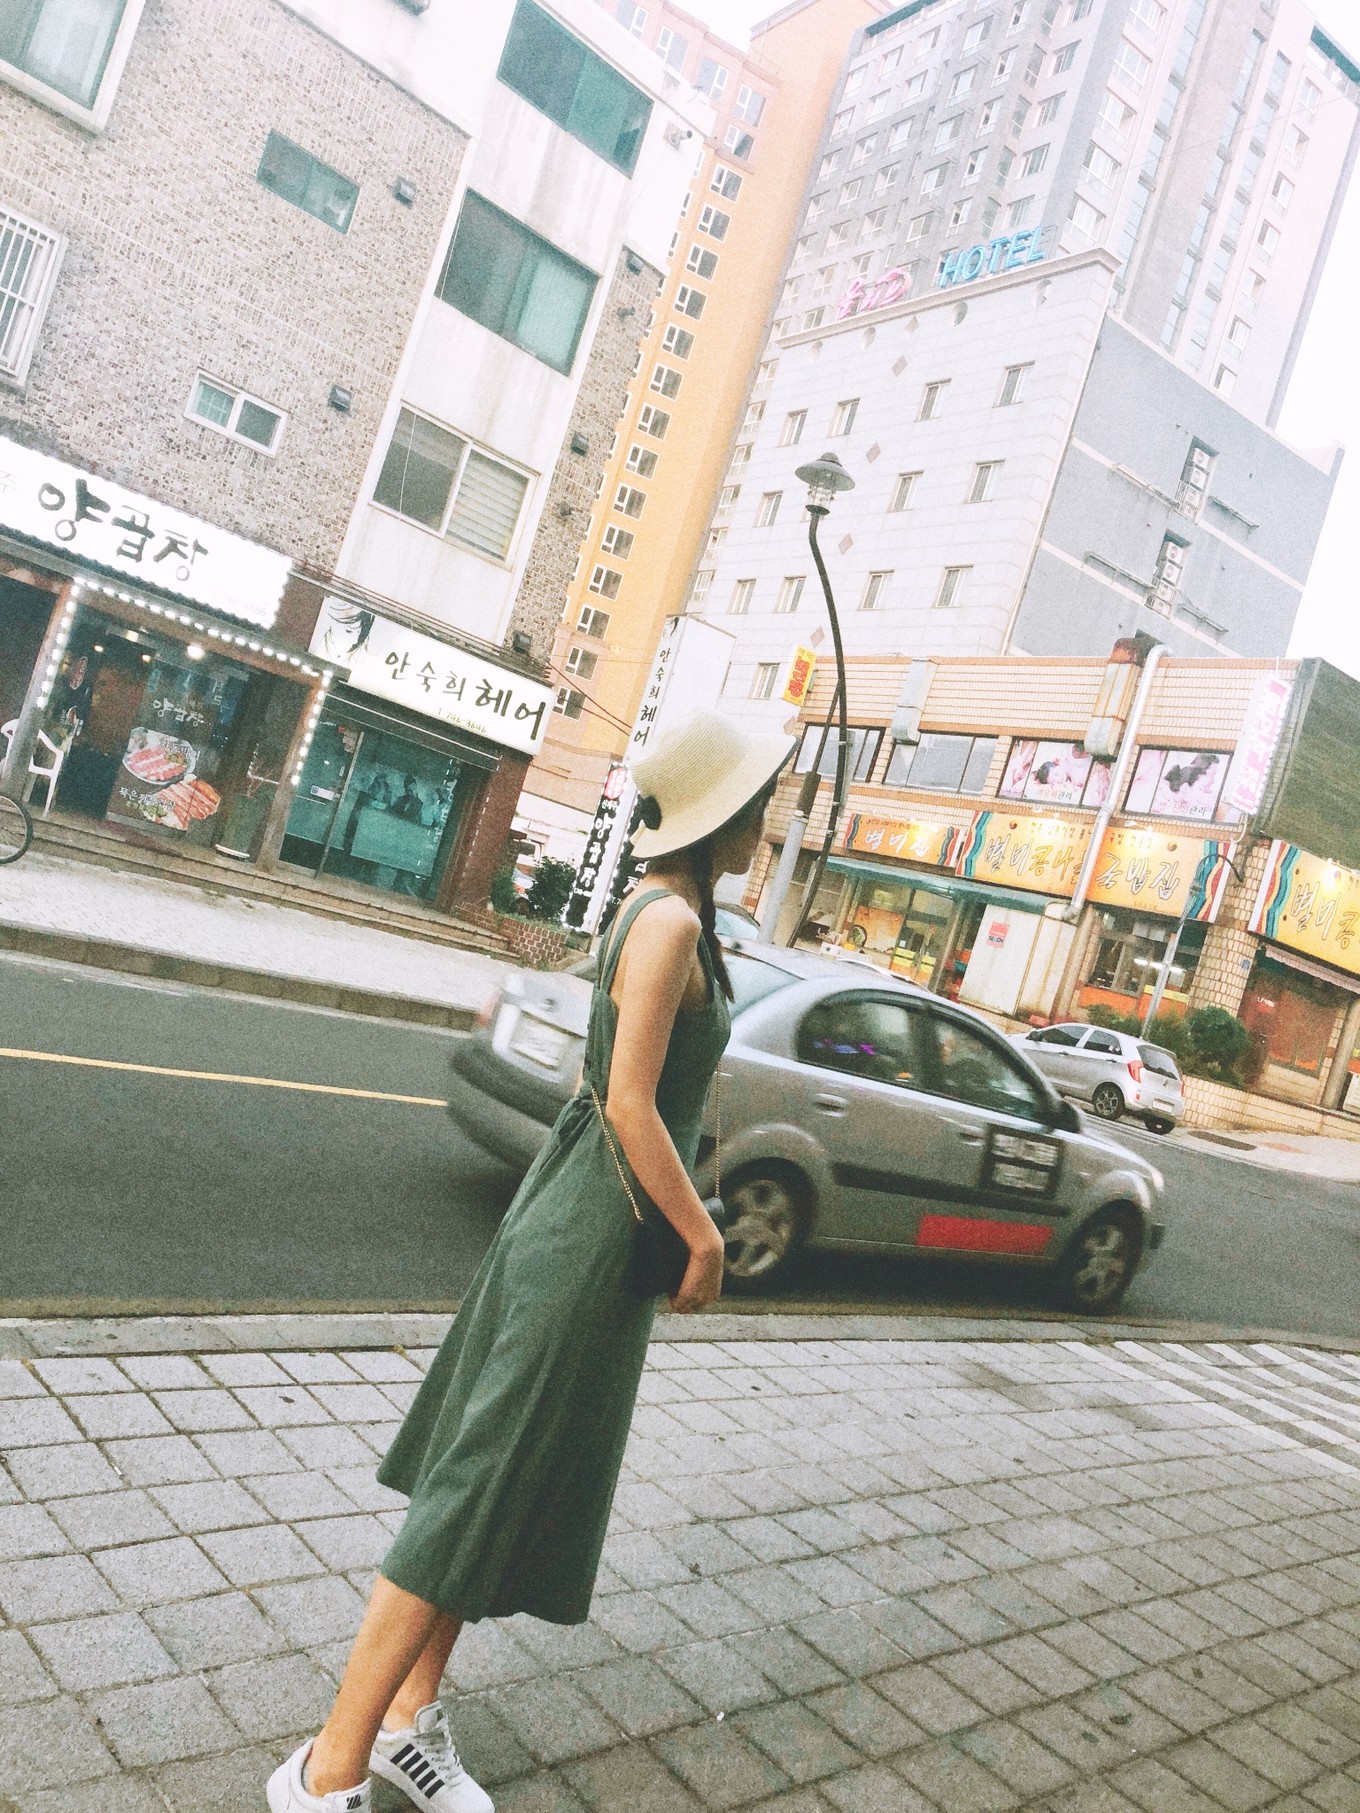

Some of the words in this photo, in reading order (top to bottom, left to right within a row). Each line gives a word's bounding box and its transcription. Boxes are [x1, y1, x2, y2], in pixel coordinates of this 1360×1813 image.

[938, 226, 1045, 288] HOTEL
[384, 651, 467, 702] 안숙희
[475, 678, 546, 741] 헤어
[648, 647, 671, 700] 안숙희
[634, 704, 658, 747] 헤어
